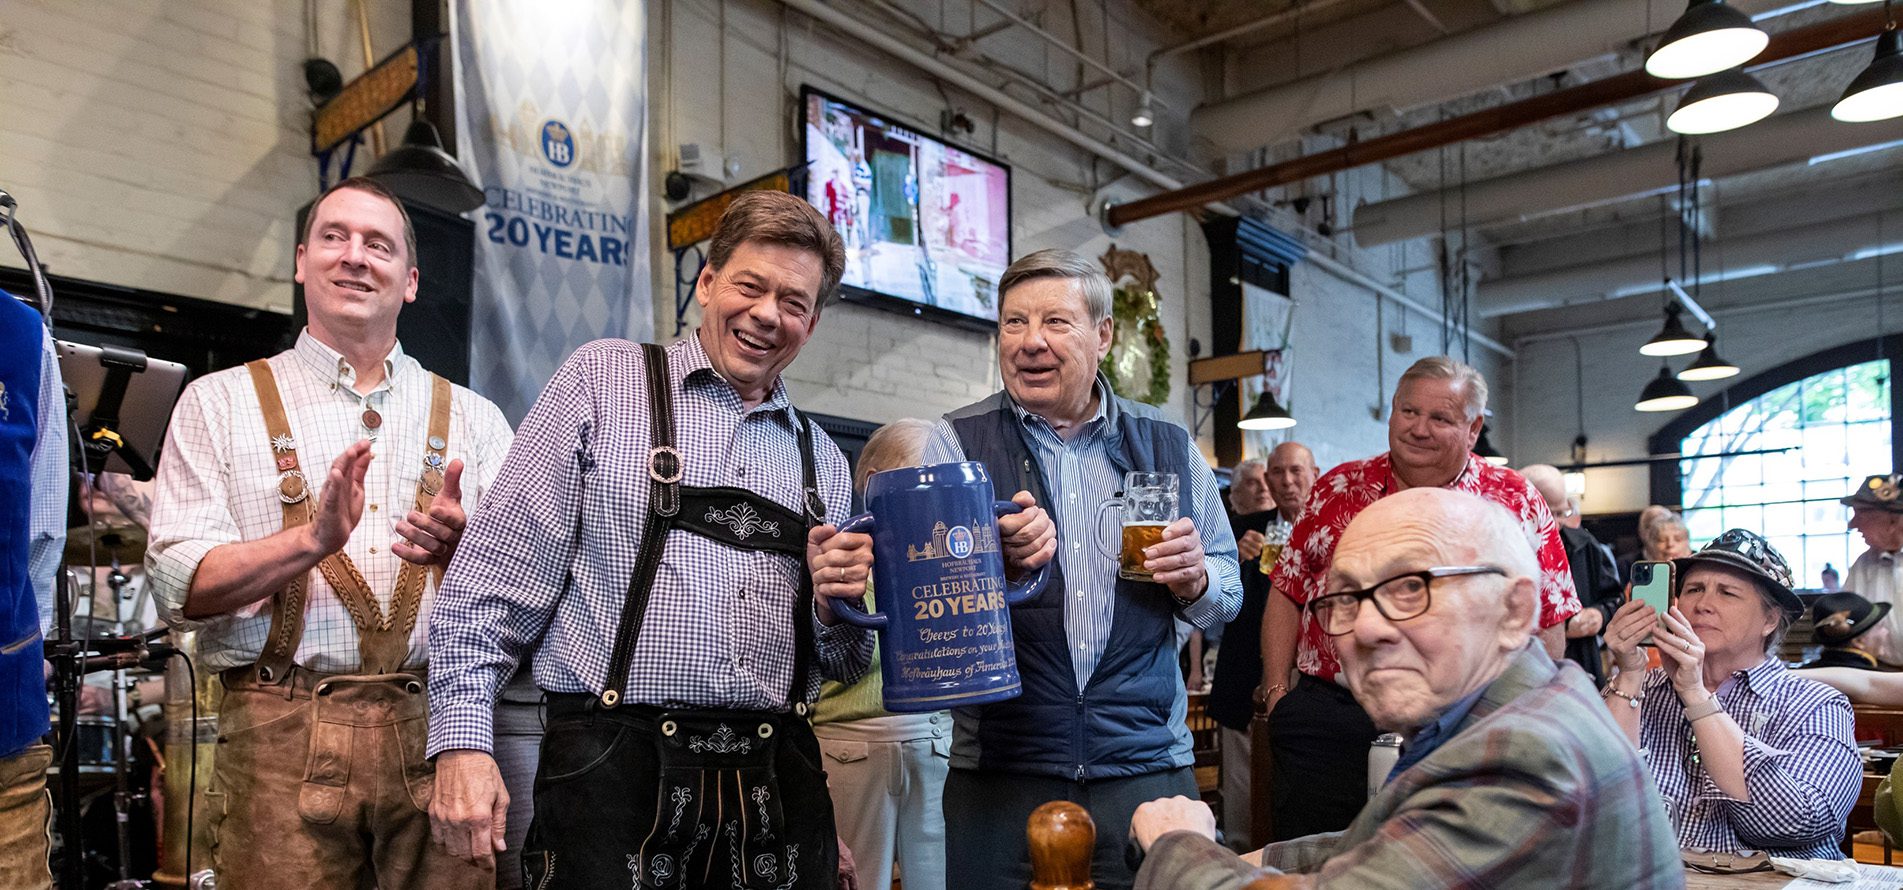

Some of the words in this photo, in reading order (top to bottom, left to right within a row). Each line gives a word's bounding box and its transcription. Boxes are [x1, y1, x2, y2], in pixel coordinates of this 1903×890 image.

[548, 141, 570, 163] HB
[485, 212, 530, 247] 20
[954, 541, 968, 554] HB
[912, 576, 1004, 600] CELEBRATING
[914, 598, 945, 621] 20
[945, 591, 1006, 616] YEARS
[918, 628, 959, 643] Cheers
[962, 625, 974, 638] to
[976, 624, 988, 636] 20
[968, 646, 978, 654] on
[976, 643, 998, 657] your
[964, 663, 976, 680] of
